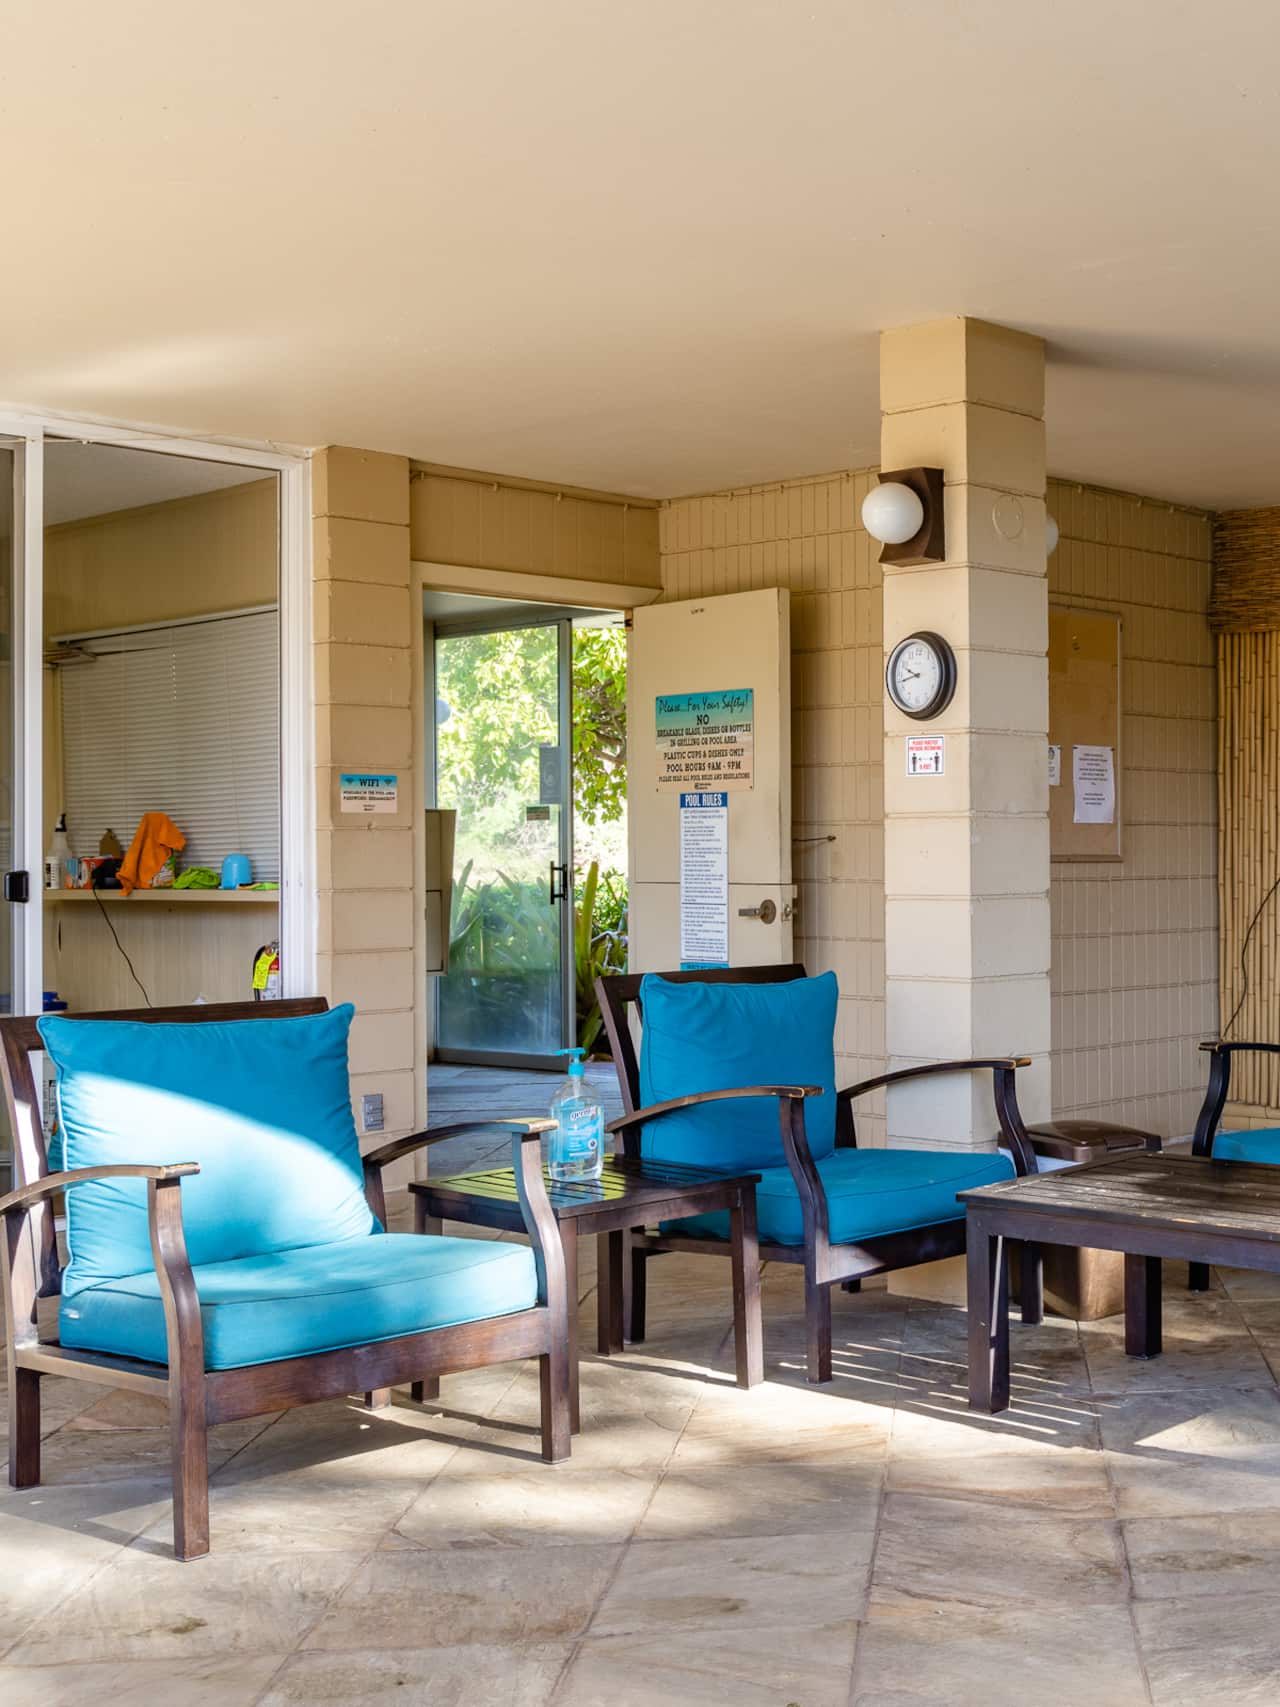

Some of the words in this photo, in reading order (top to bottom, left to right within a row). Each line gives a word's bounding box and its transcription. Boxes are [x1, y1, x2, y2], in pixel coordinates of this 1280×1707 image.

[702, 696, 720, 711] Your
[722, 693, 748, 714] Safety!
[696, 714, 710, 726] NO
[729, 724, 751, 733] BOTTLES
[709, 736, 723, 745] POOL
[724, 736, 737, 744] AREA
[664, 751, 686, 760] PLASTIC
[687, 750, 702, 759] CUPS
[666, 763, 683, 773] POOL
[685, 762, 705, 772] HOURS
[708, 761, 721, 771] 9AM
[727, 760, 741, 770] 9PM
[360, 778, 379, 787] WIFI
[685, 794, 701, 807] POOL
[702, 794, 722, 806] RULES
